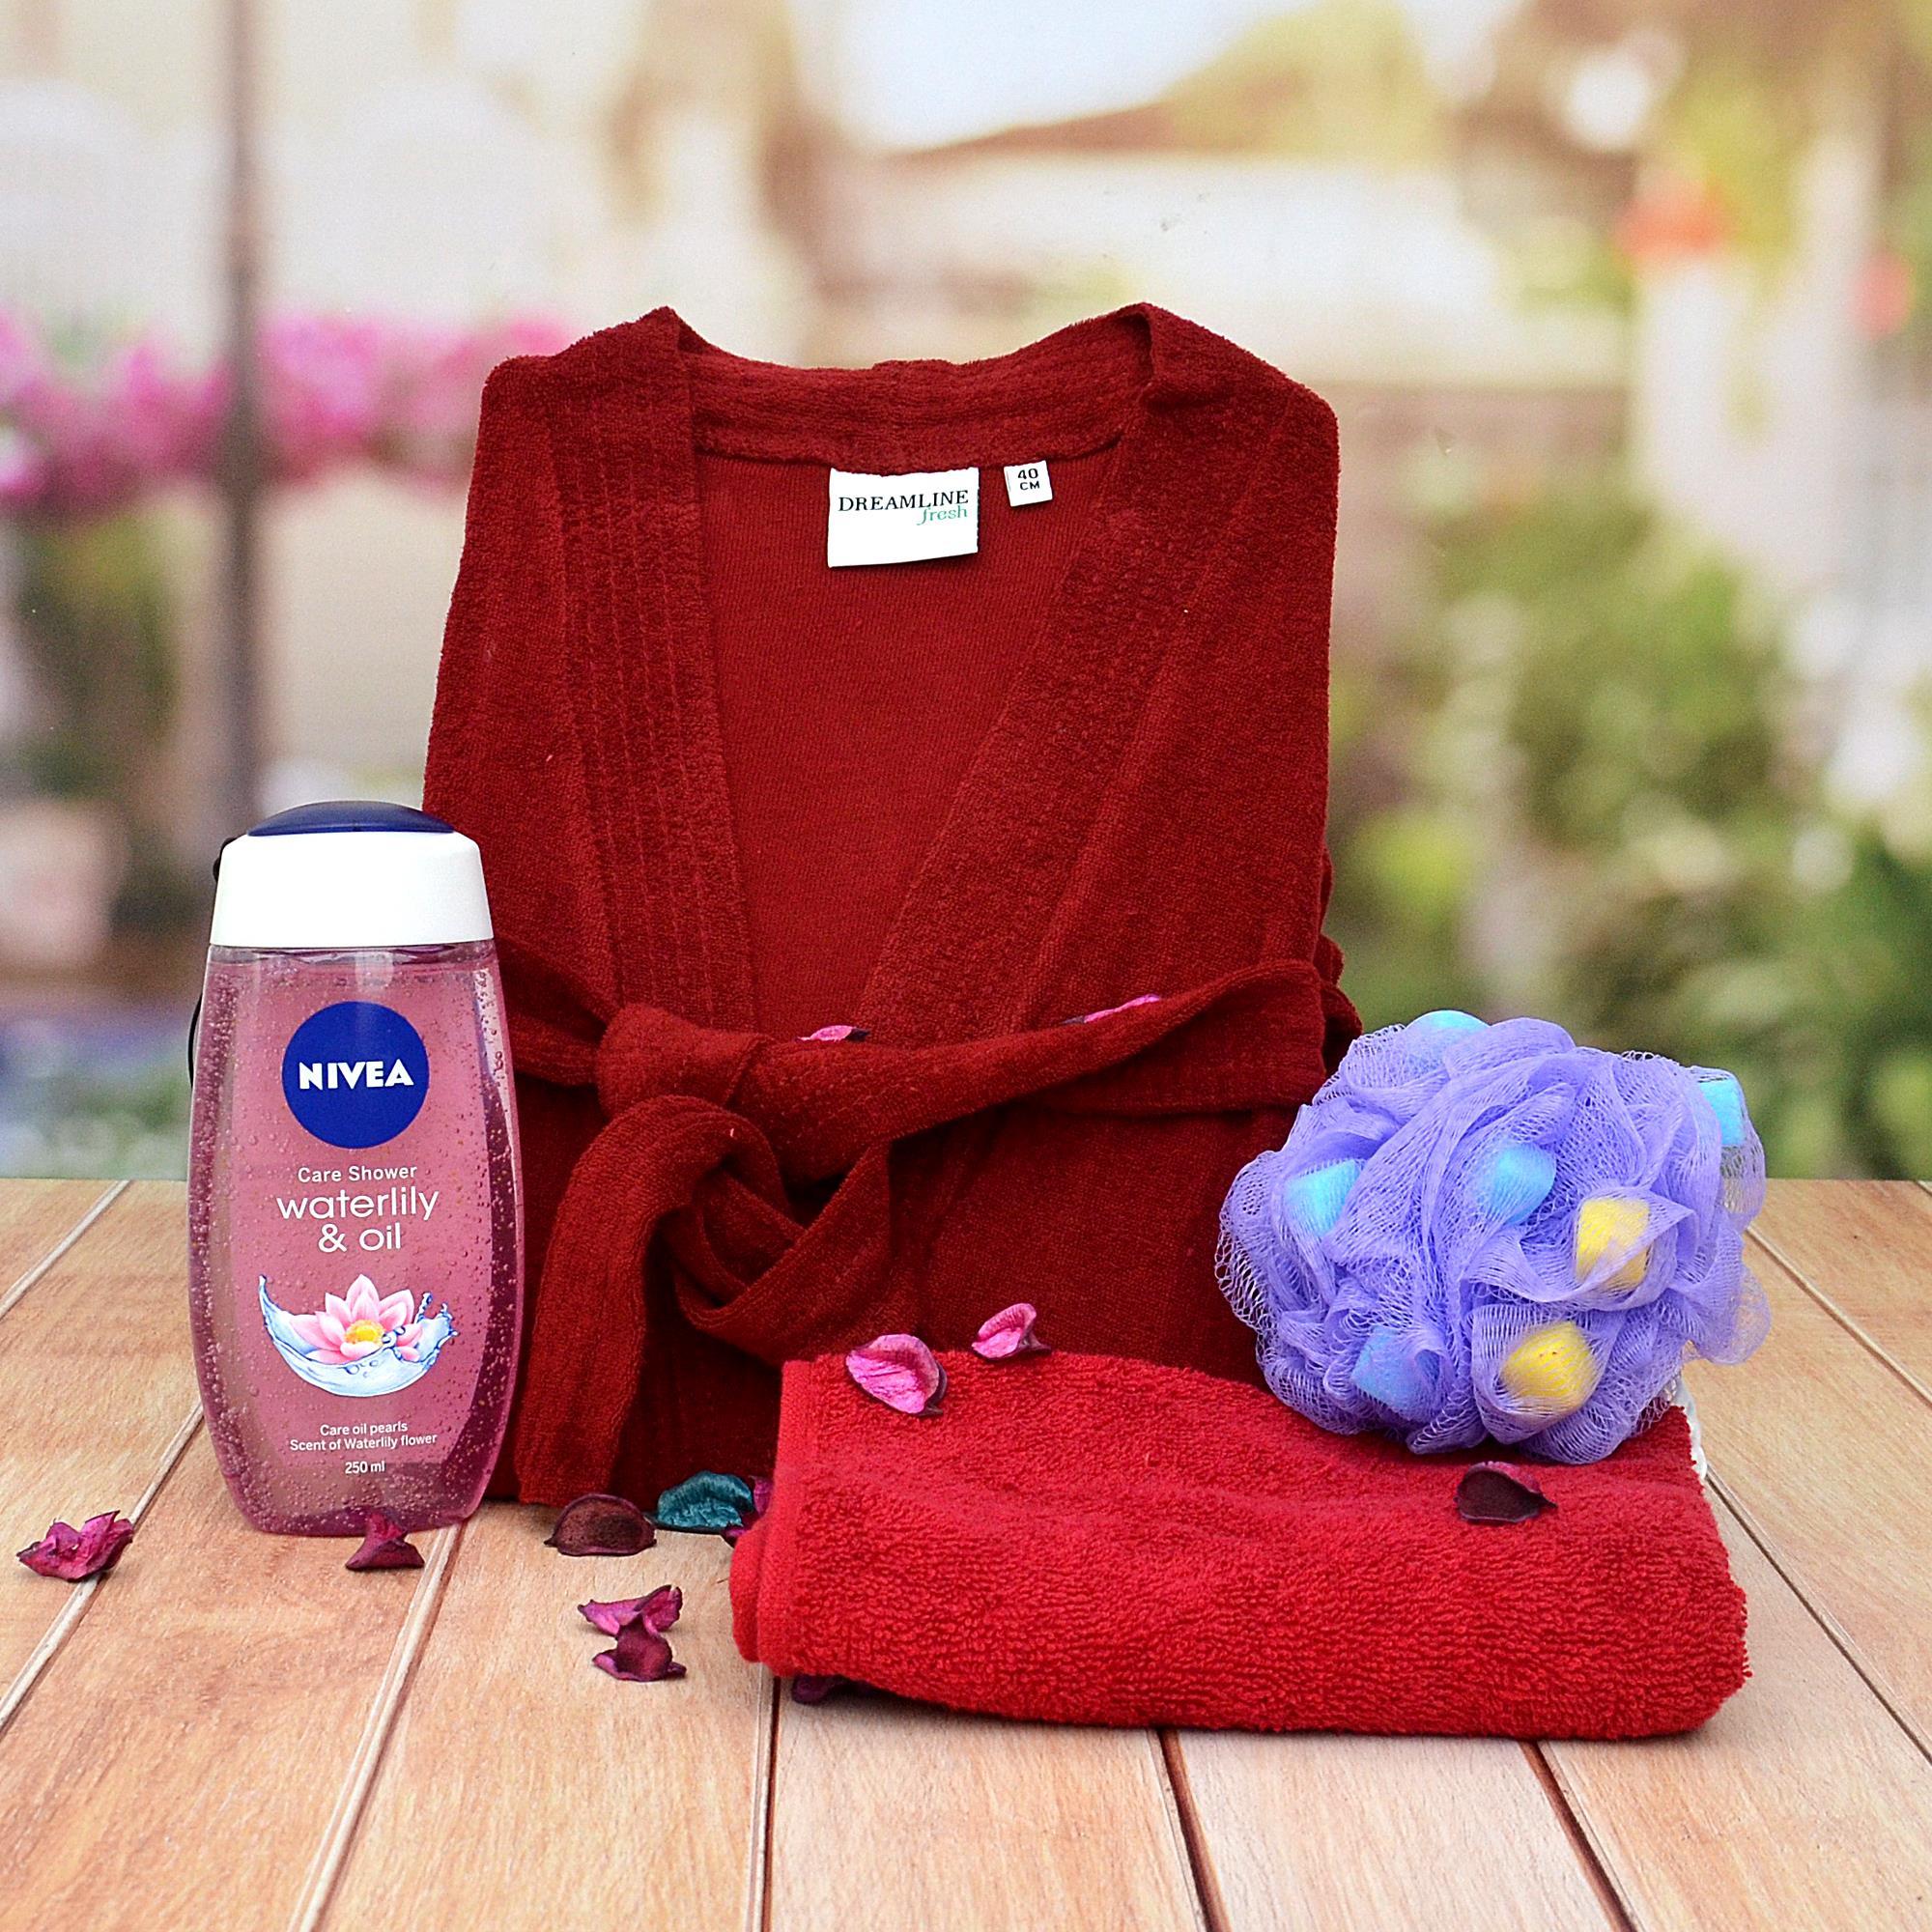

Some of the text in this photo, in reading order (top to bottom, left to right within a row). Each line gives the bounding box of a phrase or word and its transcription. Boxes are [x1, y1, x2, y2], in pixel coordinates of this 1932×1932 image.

[1017, 468, 1038, 480] 40
[1019, 481, 1040, 491] CM
[838, 490, 970, 512] DREAMLINE
[916, 505, 968, 526] fresh
[298, 1059, 414, 1091] NIVEA
[298, 1165, 417, 1183] Care Shower
[276, 1186, 440, 1221] waterlily
[318, 1222, 402, 1253] & oil
[320, 1421, 409, 1436] Care oil pearls
[290, 1433, 438, 1451] Scent of Waterlily flower
[344, 1460, 385, 1474] 250 ml
